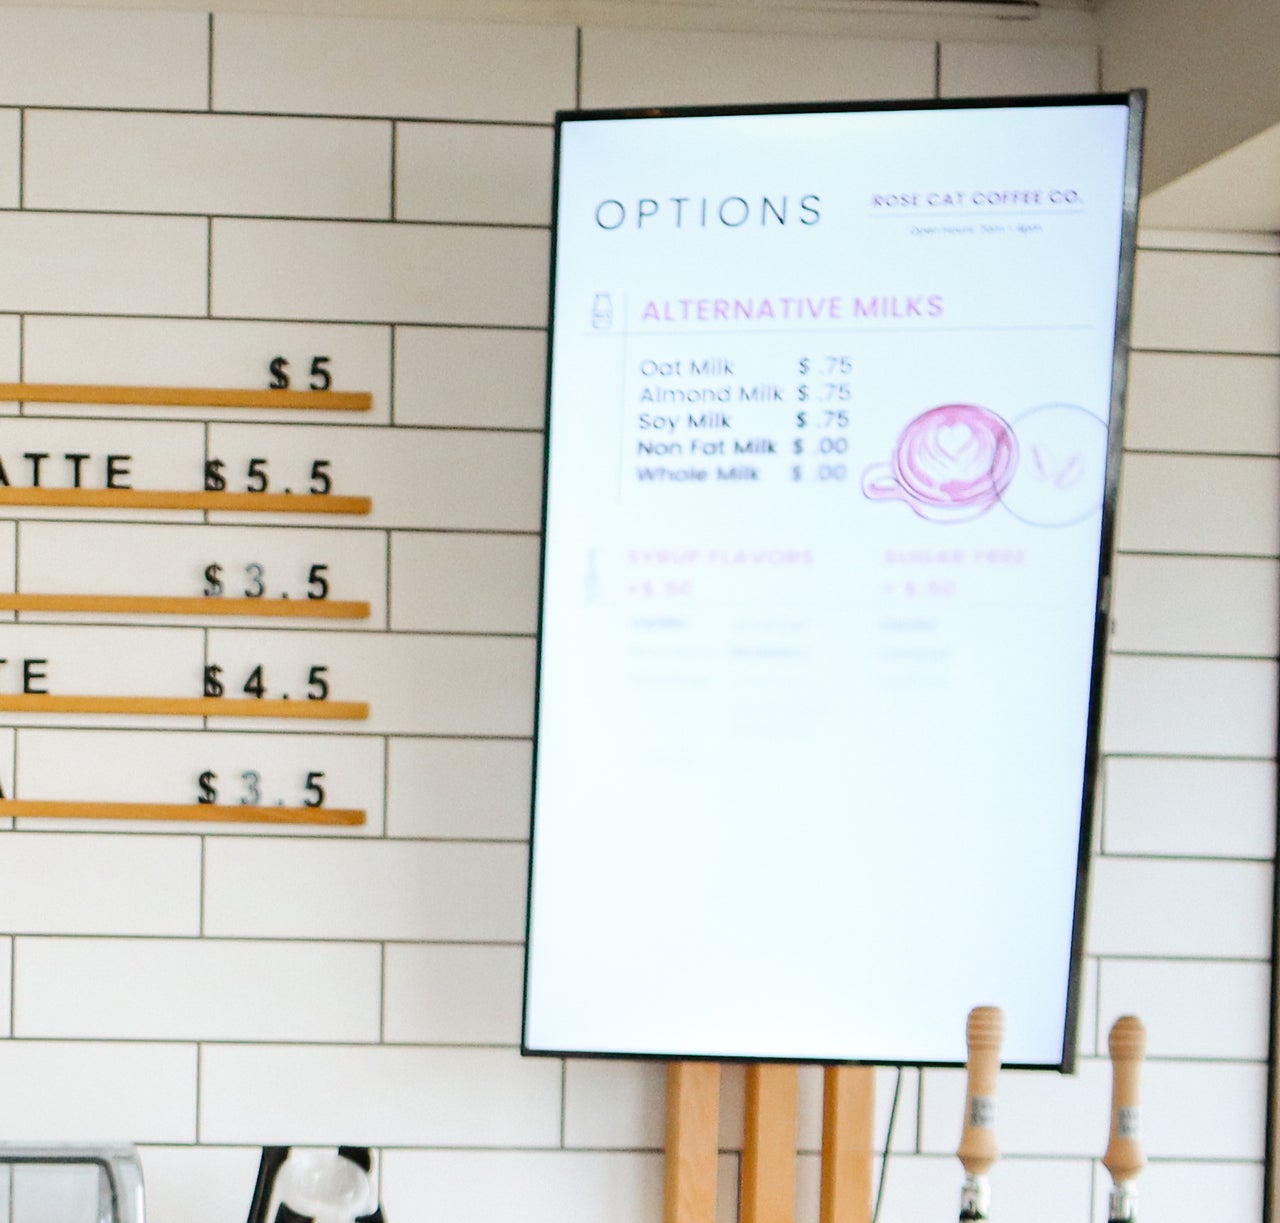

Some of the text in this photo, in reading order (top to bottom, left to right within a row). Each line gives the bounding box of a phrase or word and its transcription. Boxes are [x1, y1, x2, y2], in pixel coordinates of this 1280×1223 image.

[871, 193, 920, 207] ROSE
[926, 192, 964, 206] CAT
[972, 190, 1041, 205] COFFEE
[595, 194, 822, 230] OPTIONS
[642, 294, 944, 322] ALTERNATIVE MILKS
[640, 359, 682, 377] Oat
[690, 357, 734, 376] Milk
[640, 386, 732, 404] Almond
[739, 384, 783, 402] Milk
[639, 412, 679, 436] Soy
[689, 410, 732, 429] Milk
[637, 439, 684, 456] Non
[690, 438, 726, 456] Fat
[733, 437, 776, 455] Milk
[636, 465, 708, 482] Whole
[715, 465, 760, 482] Milk
